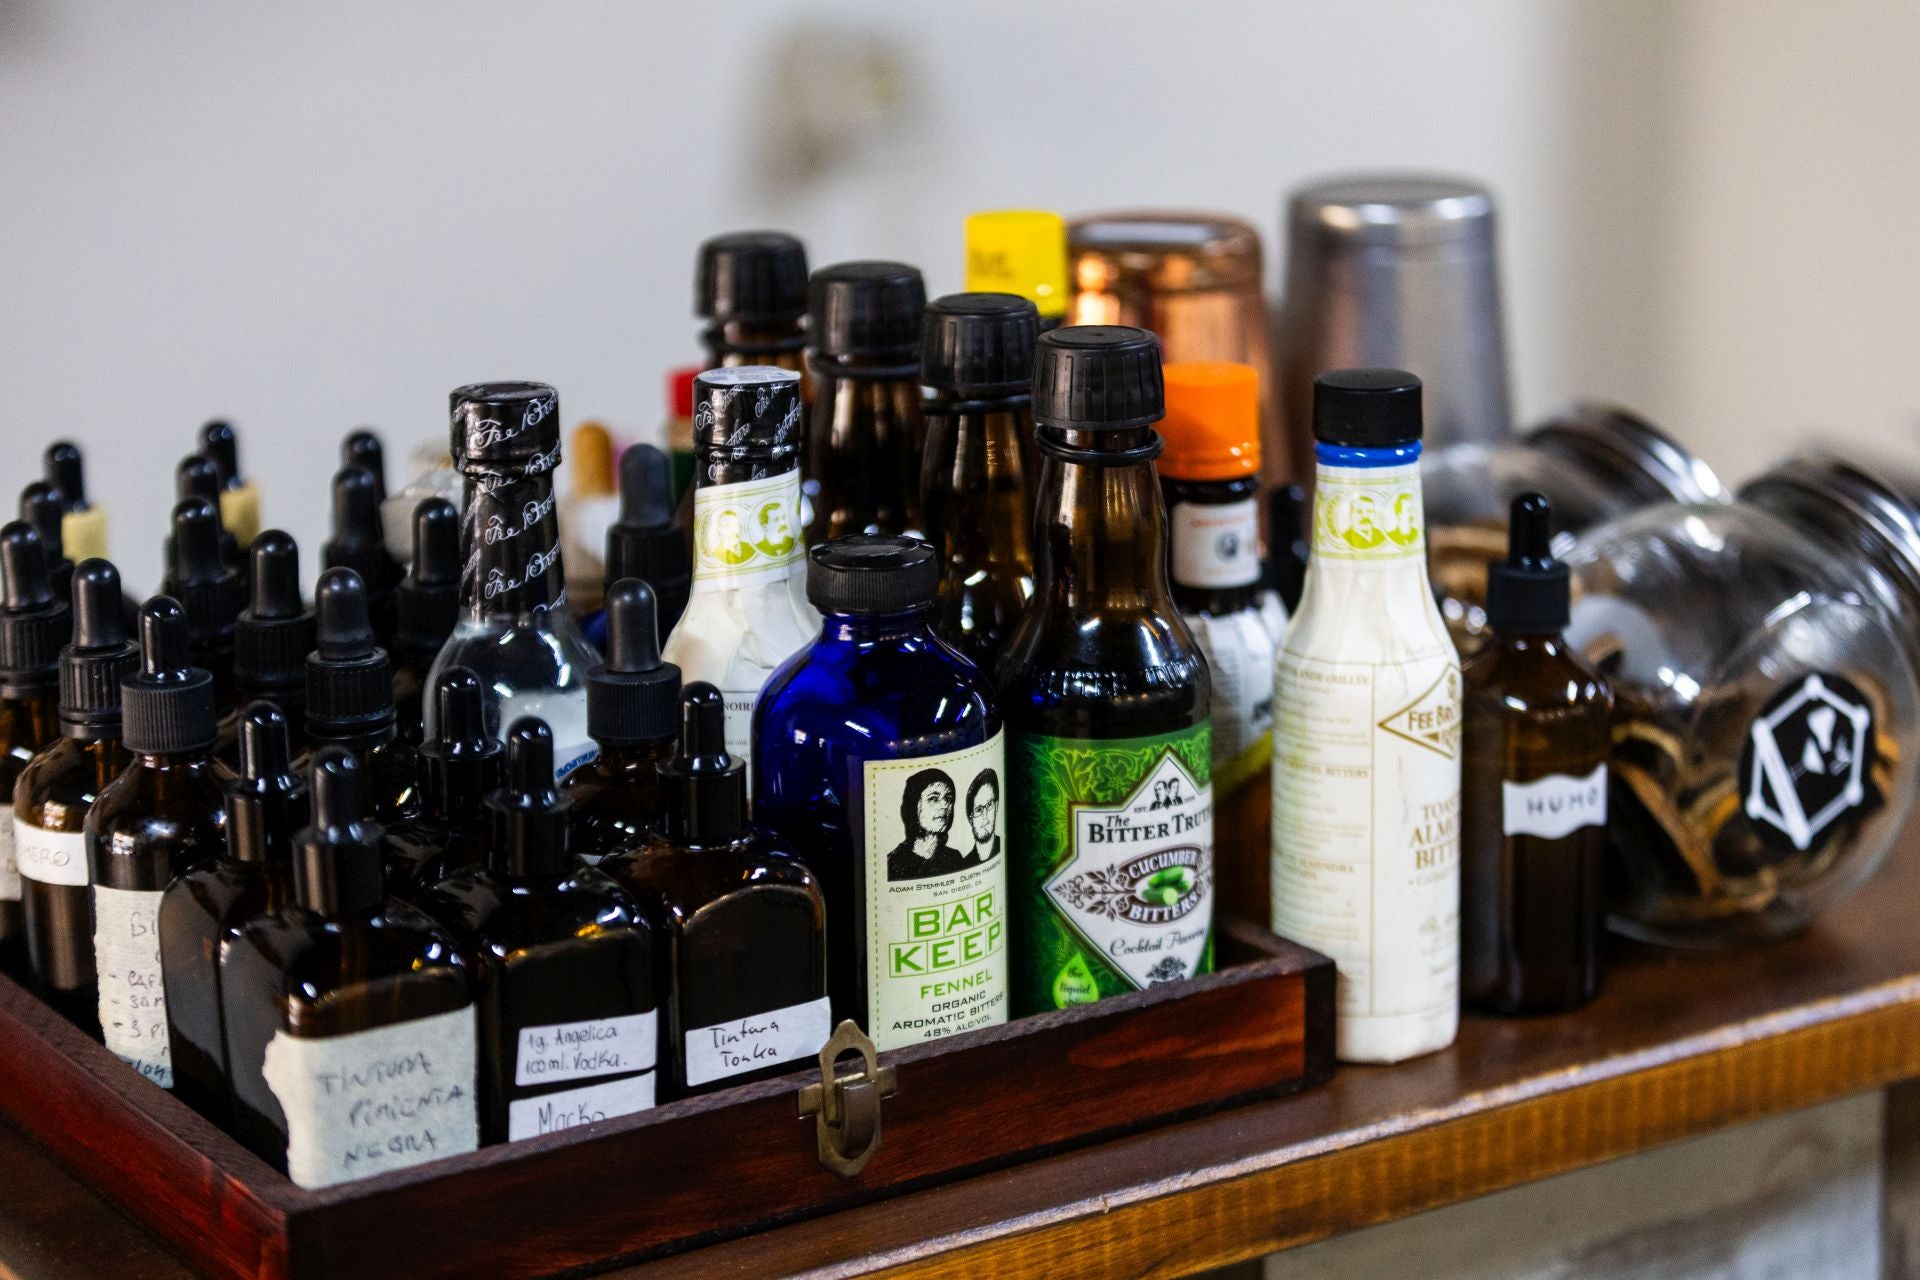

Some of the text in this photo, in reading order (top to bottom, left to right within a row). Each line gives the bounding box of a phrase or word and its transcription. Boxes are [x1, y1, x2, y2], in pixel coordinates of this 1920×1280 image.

[470, 419, 519, 449] Fee
[484, 515, 521, 545] Fee
[484, 568, 522, 599] Fee
[1408, 710, 1433, 732] FEE
[1105, 814, 1130, 828] The
[1088, 823, 1170, 843] BITTER
[1128, 850, 1197, 879] CUCUMBER
[916, 879, 955, 891] STEMMLER
[933, 889, 948, 897] SAN
[913, 893, 993, 937] BAR
[1129, 892, 1199, 921] BITTERS
[895, 921, 1000, 973] KEEP
[1110, 937, 1162, 957] Cocktail
[920, 969, 993, 999] FENNEL
[932, 991, 986, 1012] ORGANIC
[892, 1011, 965, 1030] AROMATIC
[554, 1025, 618, 1048] Angelica
[924, 1027, 951, 1038] 48%
[721, 1043, 777, 1067] Tonka
